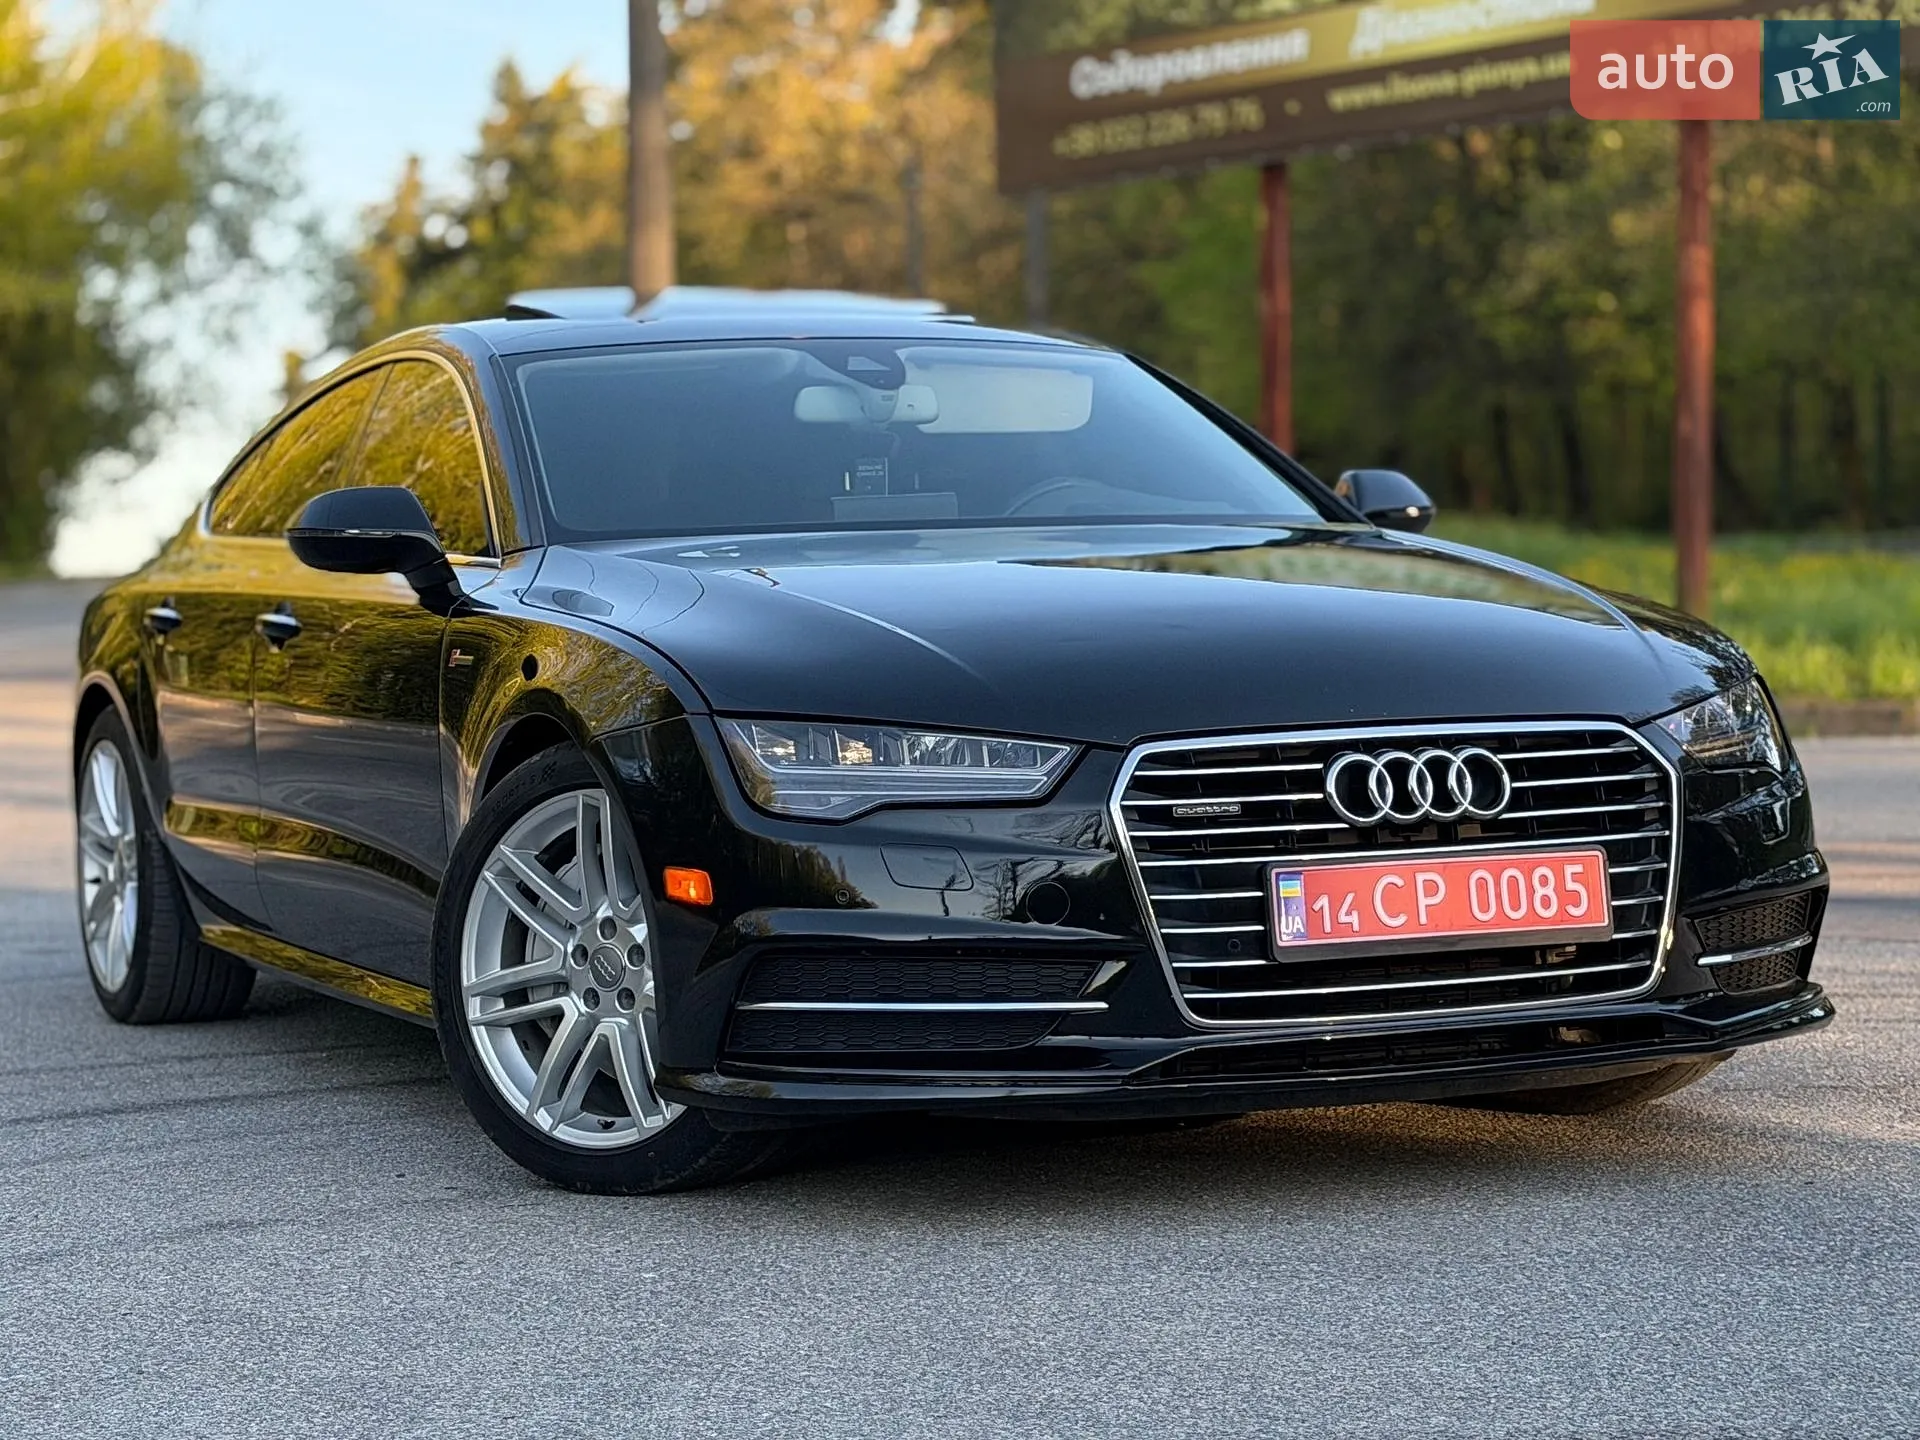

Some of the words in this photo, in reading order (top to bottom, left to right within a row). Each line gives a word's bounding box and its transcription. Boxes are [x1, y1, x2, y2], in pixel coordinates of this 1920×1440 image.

[1176, 805, 1239, 815] quattro
[1312, 892, 1360, 934] 14
[1373, 868, 1447, 928] CP
[1468, 863, 1589, 924] 0085
[1281, 915, 1305, 934] UA
